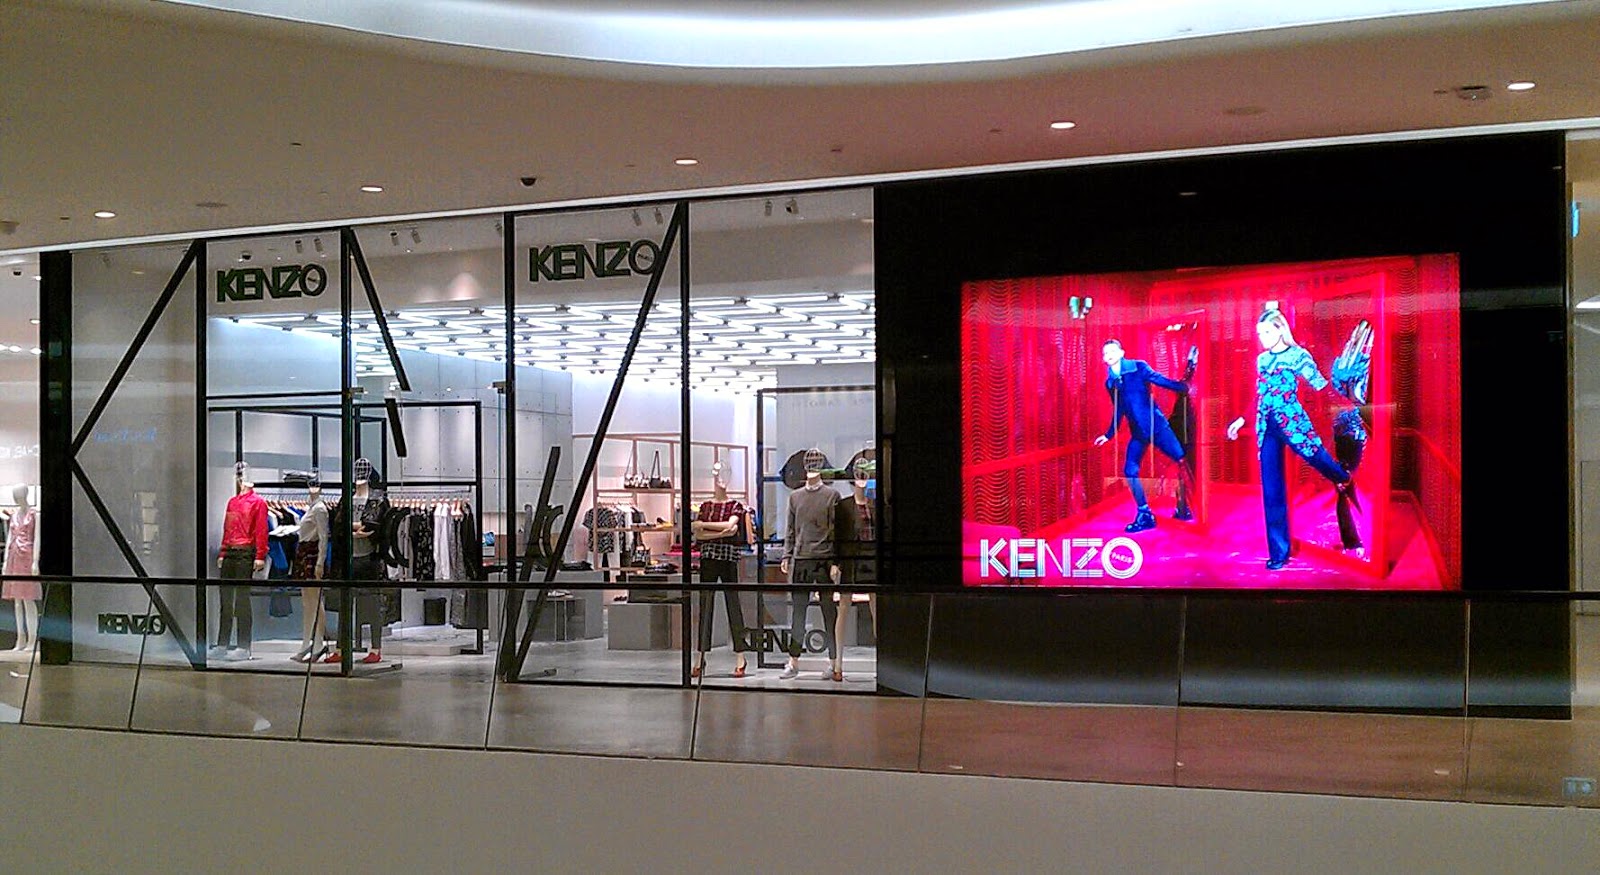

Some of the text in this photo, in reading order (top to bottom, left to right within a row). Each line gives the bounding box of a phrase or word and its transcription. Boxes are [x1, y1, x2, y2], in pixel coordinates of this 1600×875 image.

[529, 240, 660, 281] KENZO
[217, 264, 327, 302] KENZO
[980, 537, 1143, 579] KENZO
[98, 613, 166, 634] KENZO
